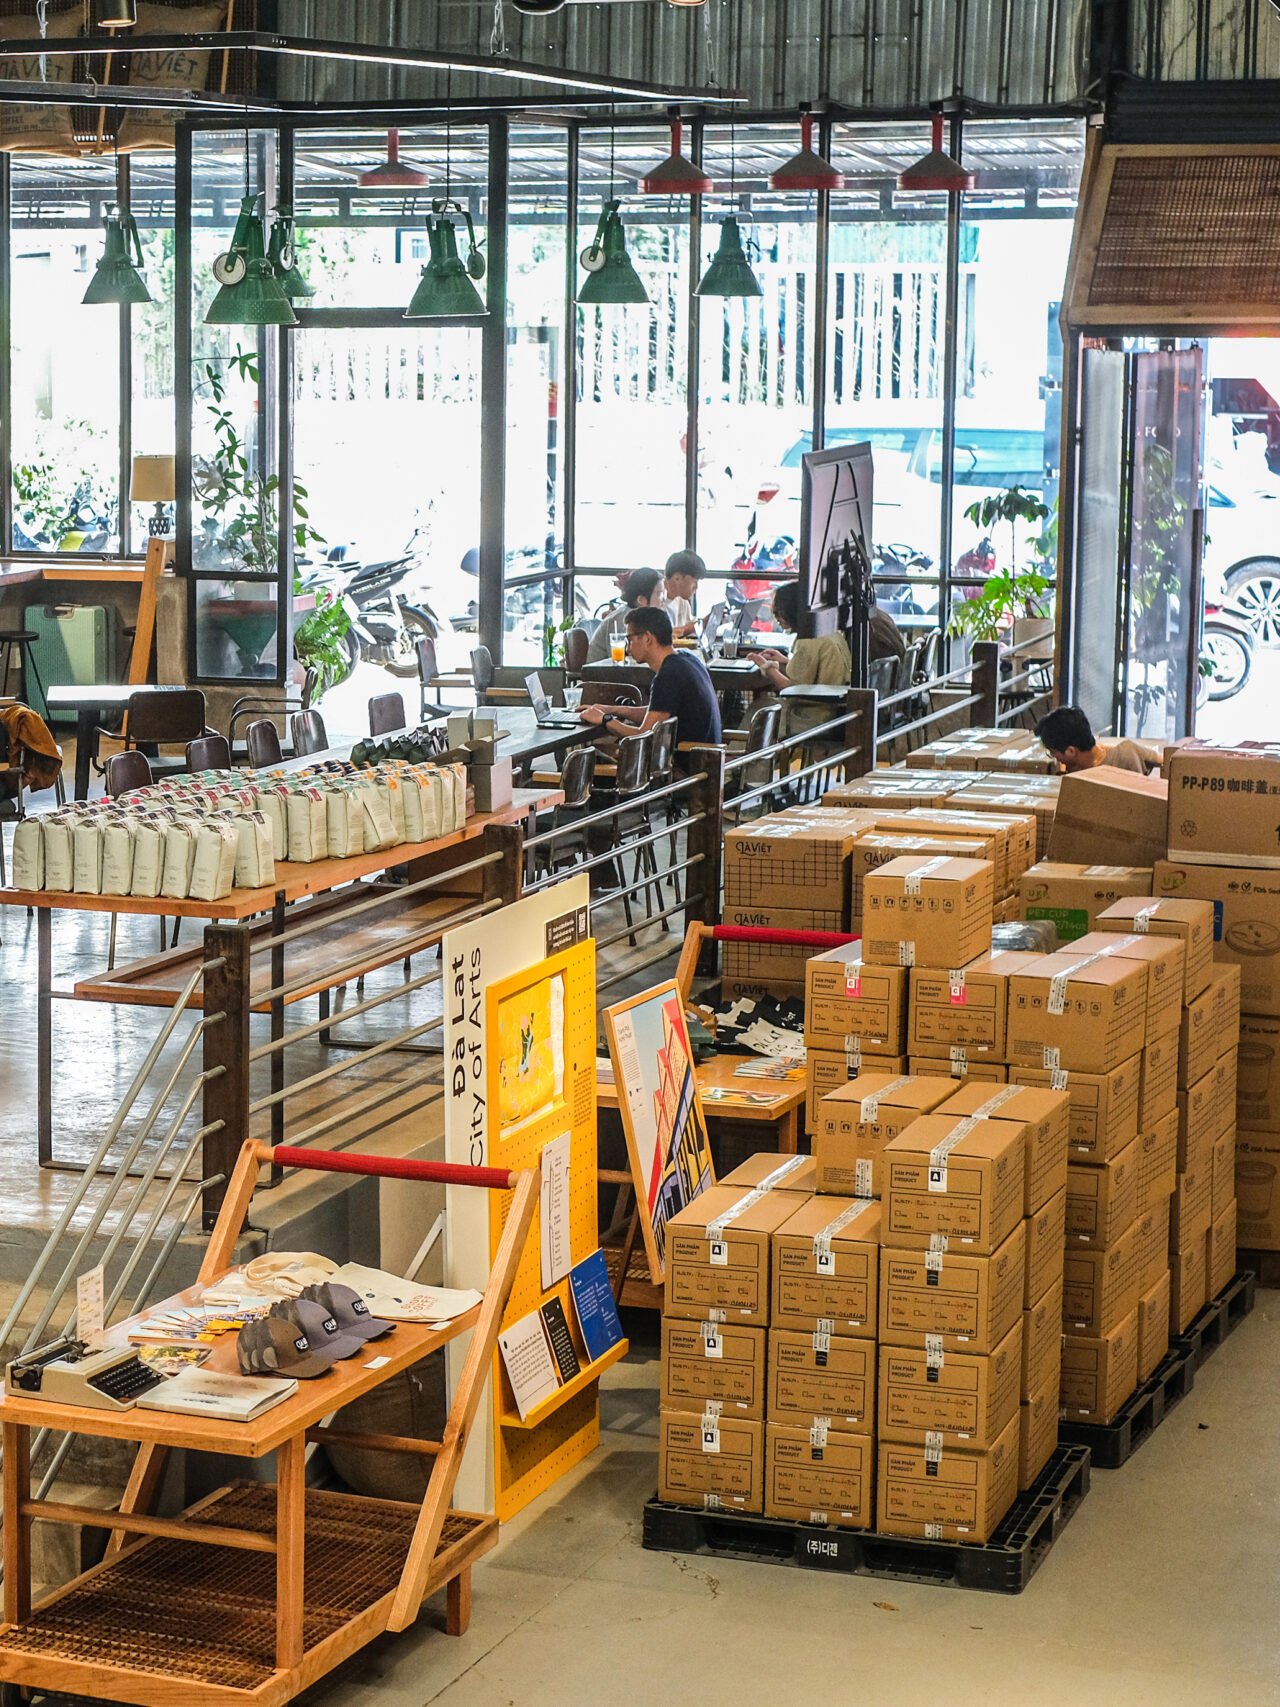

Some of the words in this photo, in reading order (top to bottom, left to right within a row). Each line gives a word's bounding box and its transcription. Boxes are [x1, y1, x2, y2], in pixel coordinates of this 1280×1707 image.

[1182, 775, 1225, 792] PP-P89
[451, 953, 466, 1025] Lat
[468, 946, 482, 1028] Arts
[452, 1036, 466, 1098] Đà
[468, 1041, 483, 1080] of
[470, 1092, 486, 1168] City
[807, 1539, 838, 1557] (주)디젠
